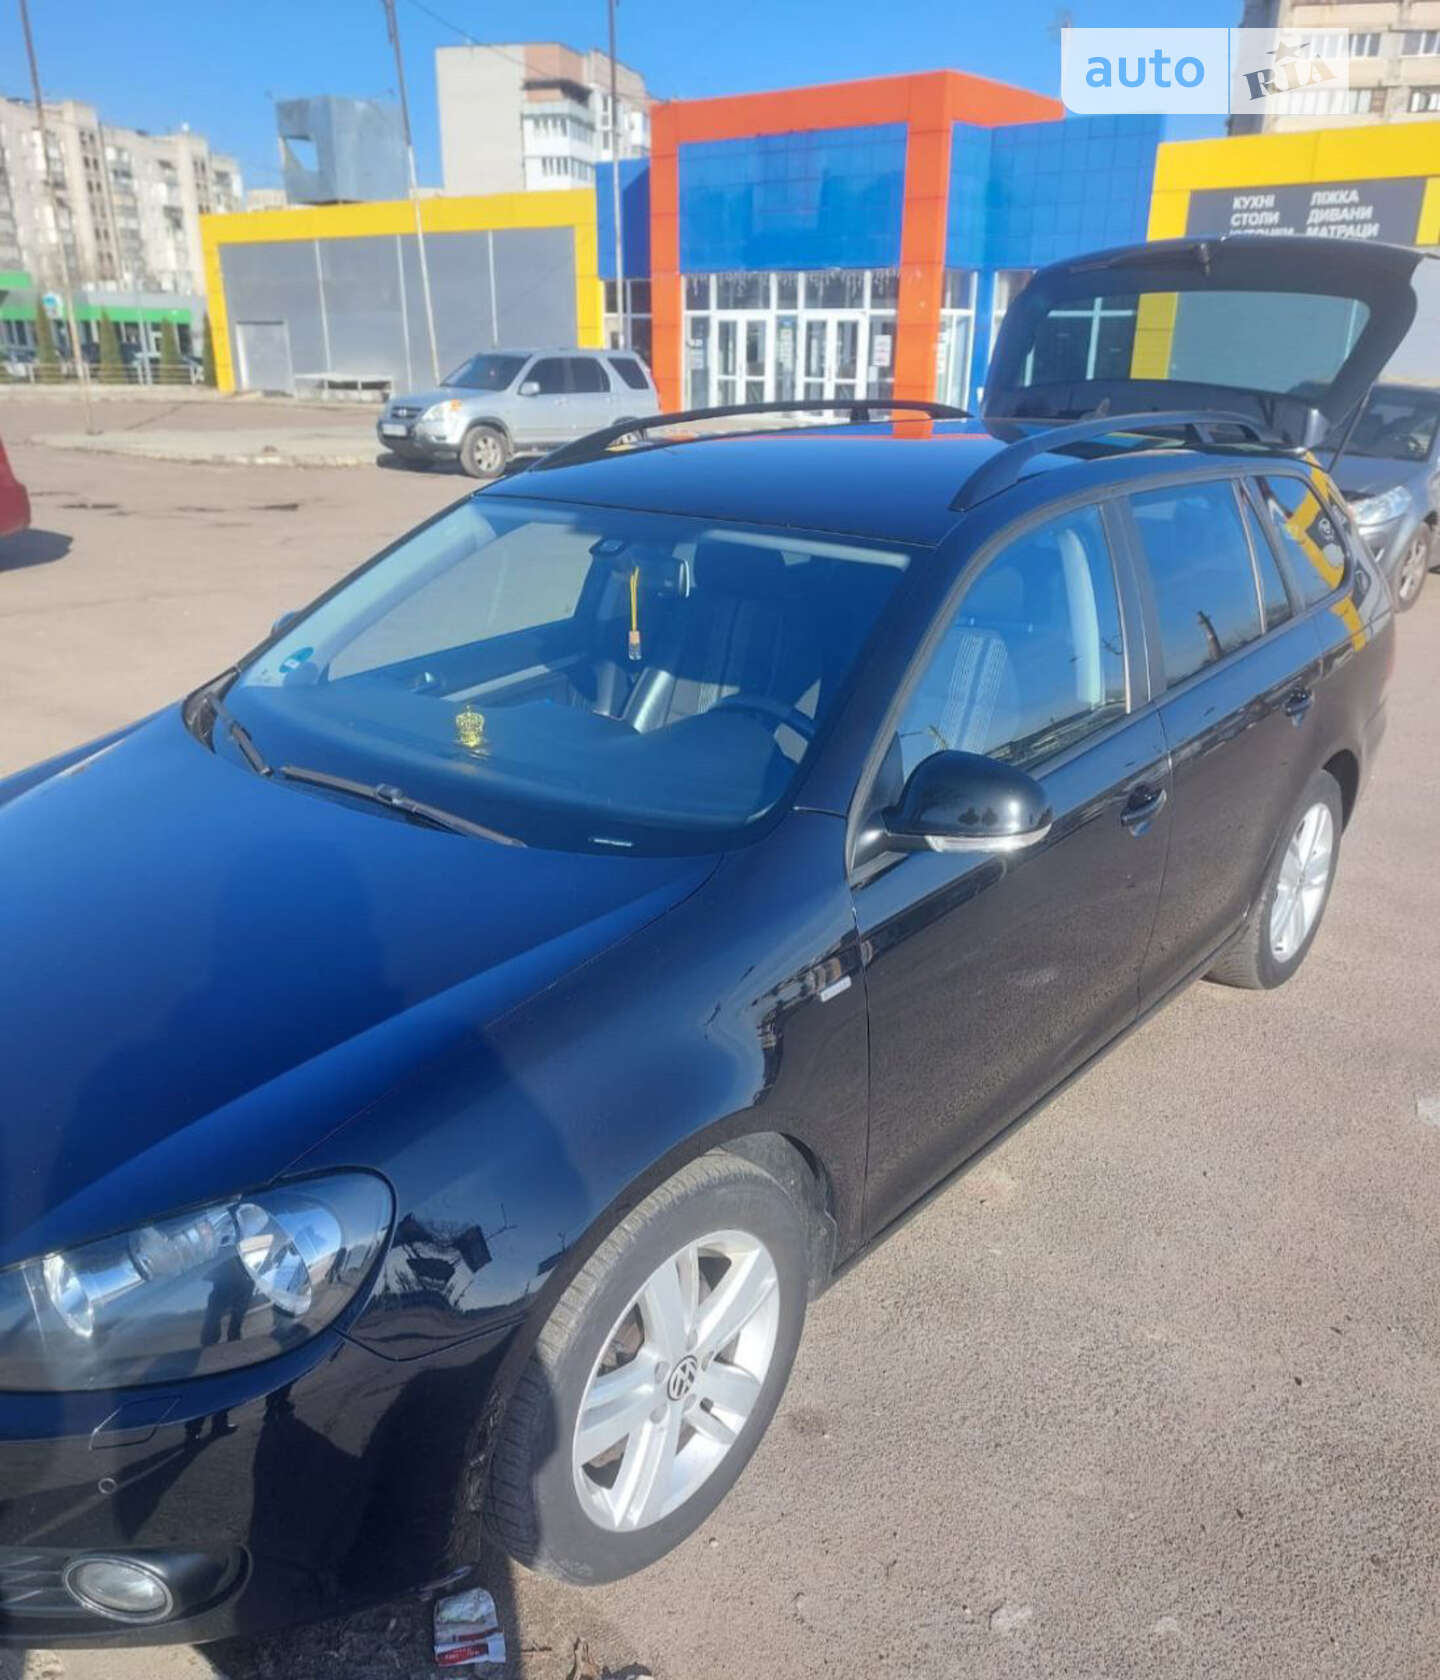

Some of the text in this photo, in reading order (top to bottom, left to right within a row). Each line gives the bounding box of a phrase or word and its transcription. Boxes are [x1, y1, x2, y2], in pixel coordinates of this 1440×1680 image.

[1233, 194, 1275, 209] КУХНІ
[1311, 190, 1359, 206] ЛІЖКА
[1230, 211, 1280, 226] СТОЛИ
[1306, 206, 1373, 225] ДИВАНИ
[1305, 223, 1379, 239] МАТРАЦИ
